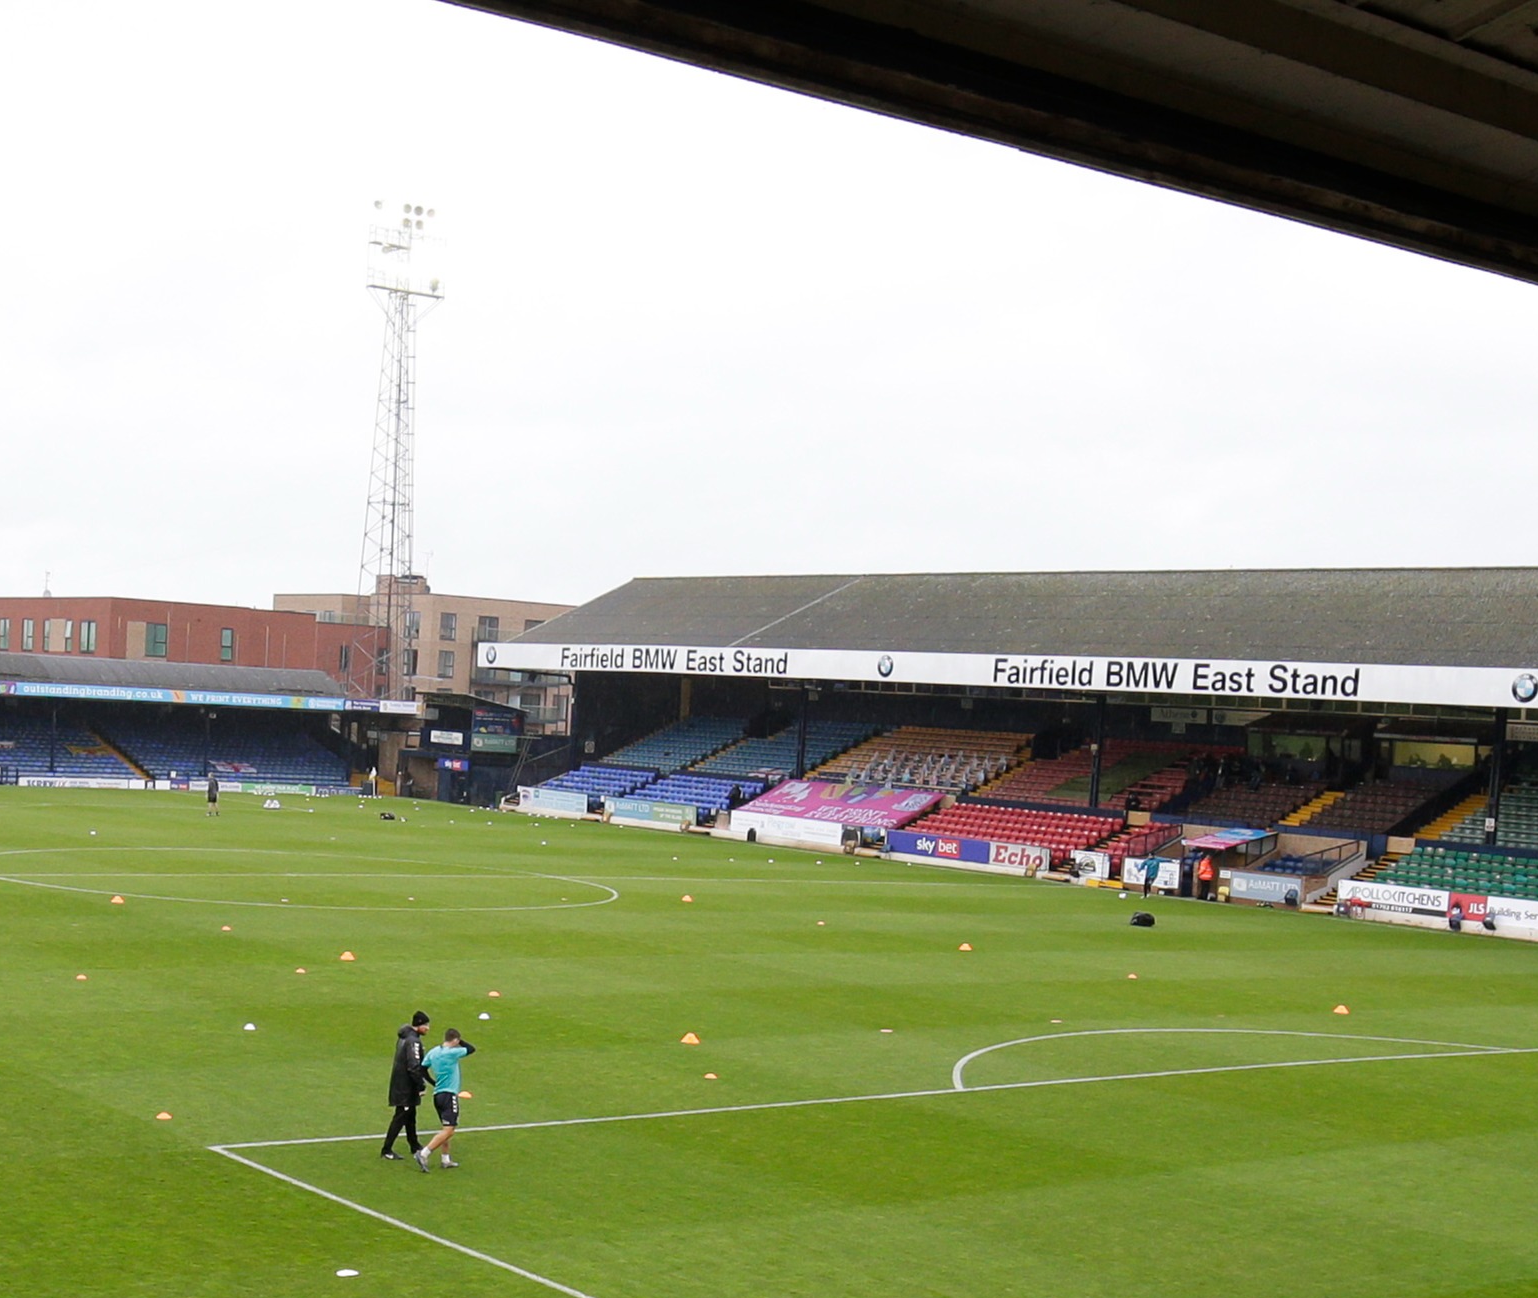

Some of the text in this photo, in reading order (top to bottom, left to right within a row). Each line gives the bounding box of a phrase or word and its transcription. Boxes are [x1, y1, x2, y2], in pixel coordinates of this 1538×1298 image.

[561, 647, 788, 675] Fairfield BMW East Stand
[993, 658, 1360, 697] Fairfield BMW East Stand
[23, 685, 163, 700] outstandingbranding.co.uk
[232, 696, 282, 706] EVERYTHING
[916, 836, 958, 854] sky bet
[992, 845, 1044, 868] Echo
[1469, 903, 1485, 914] JLS
[1489, 906, 1521, 920] Building
